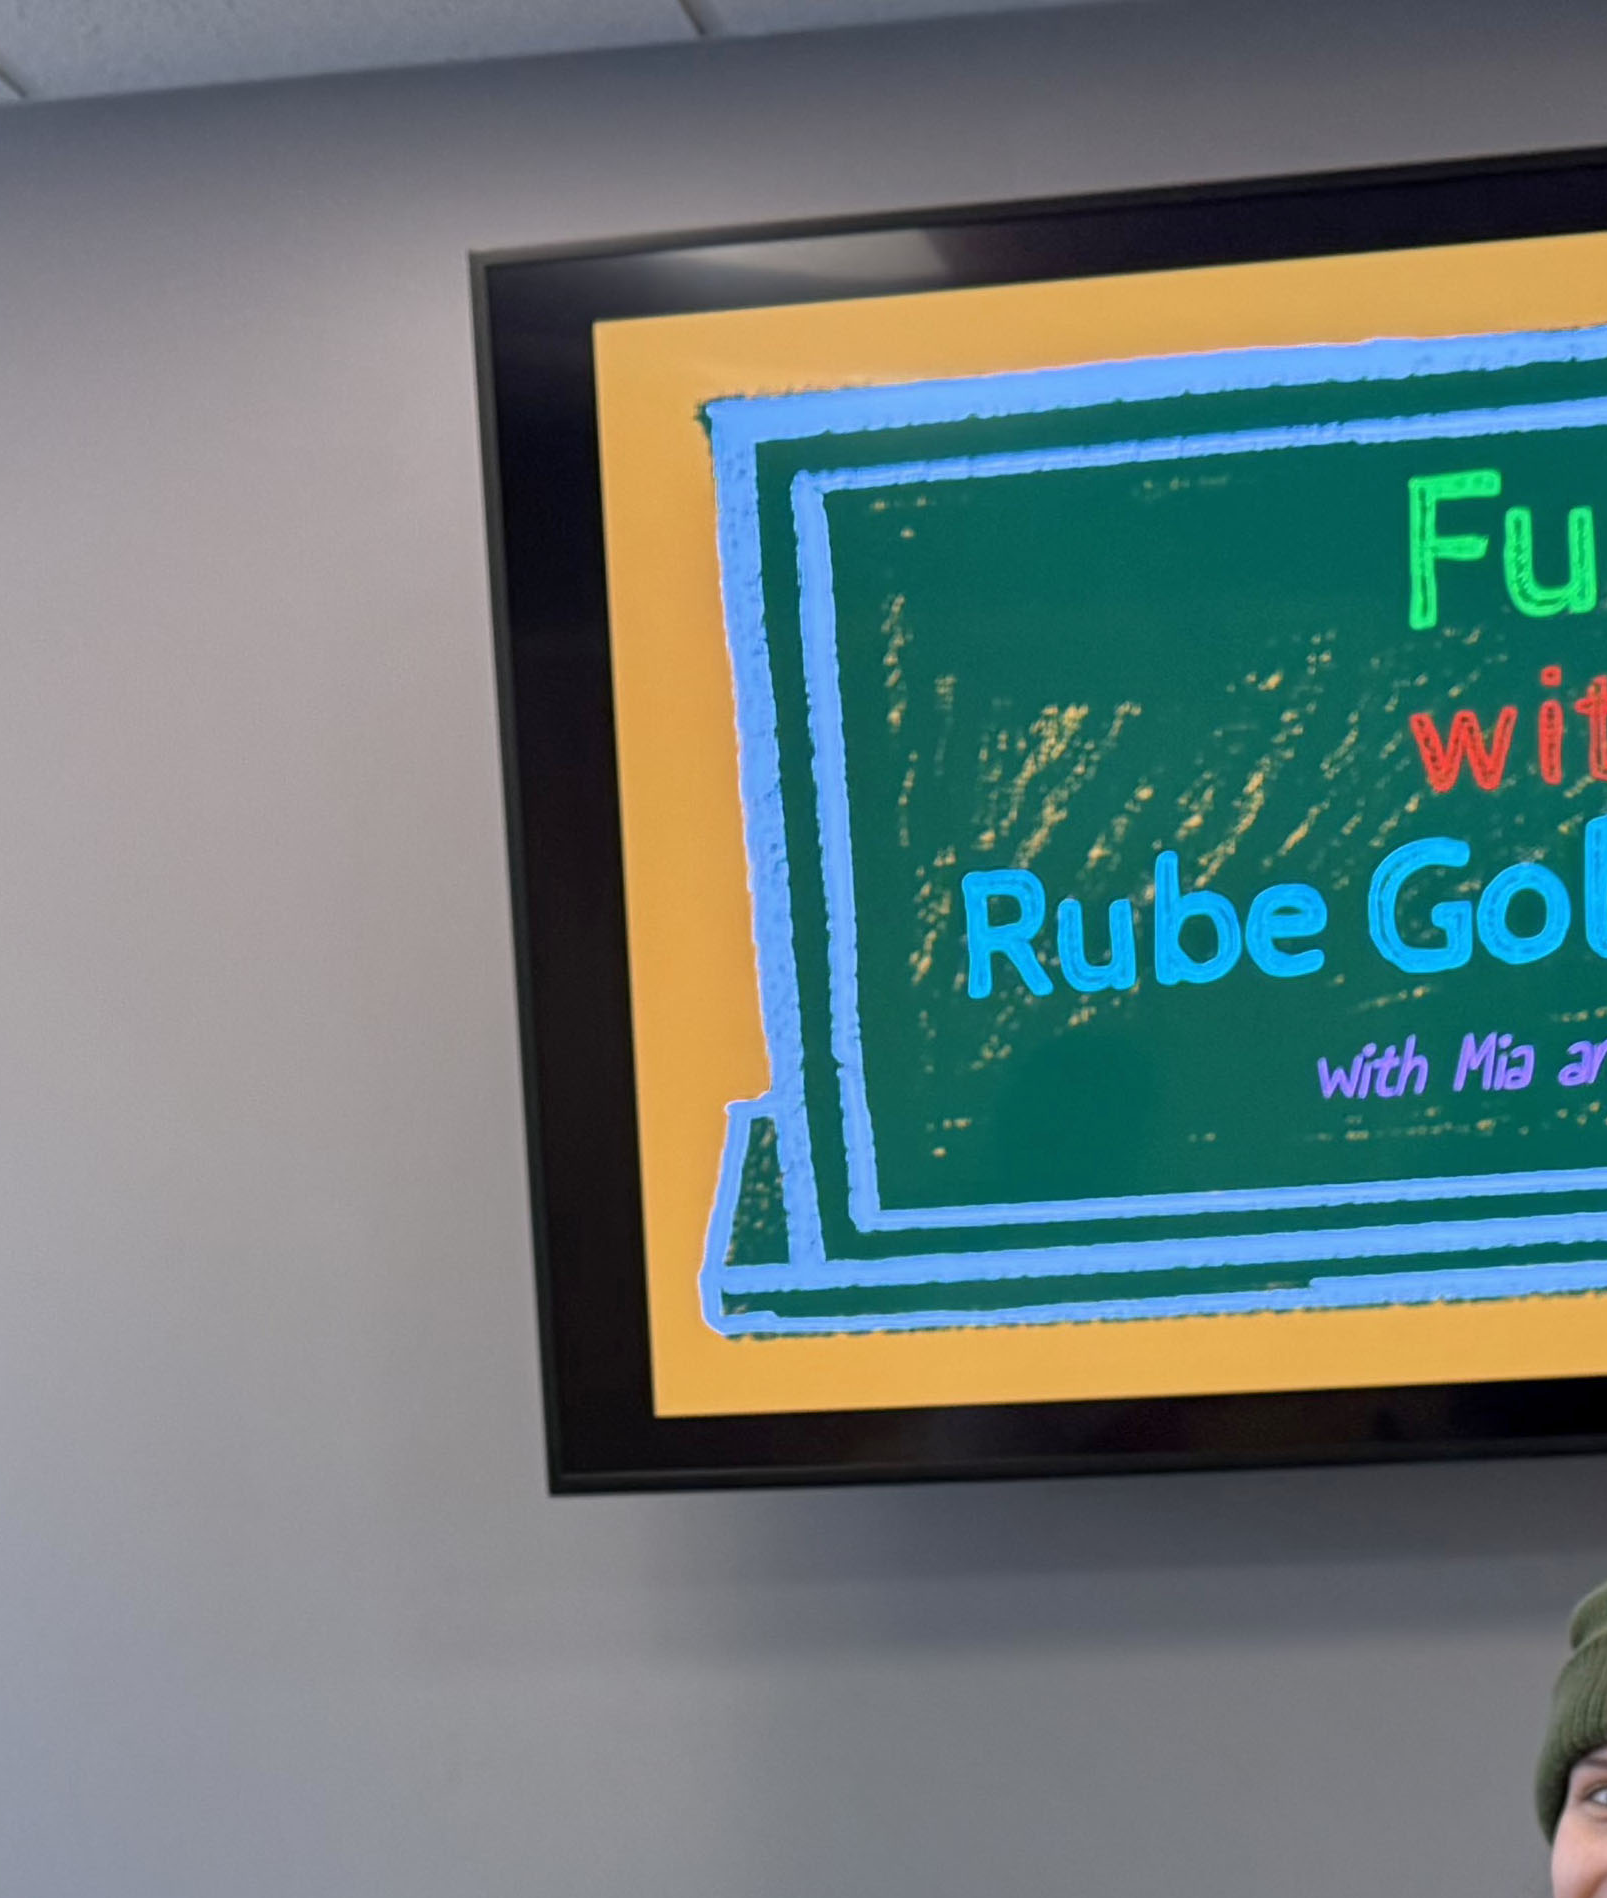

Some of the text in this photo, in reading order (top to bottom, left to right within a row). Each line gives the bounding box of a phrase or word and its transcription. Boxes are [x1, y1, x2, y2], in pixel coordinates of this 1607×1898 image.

[961, 850, 1327, 1000] Rube
[1317, 1034, 1429, 1099] with
[1453, 1032, 1535, 1092] Mia
